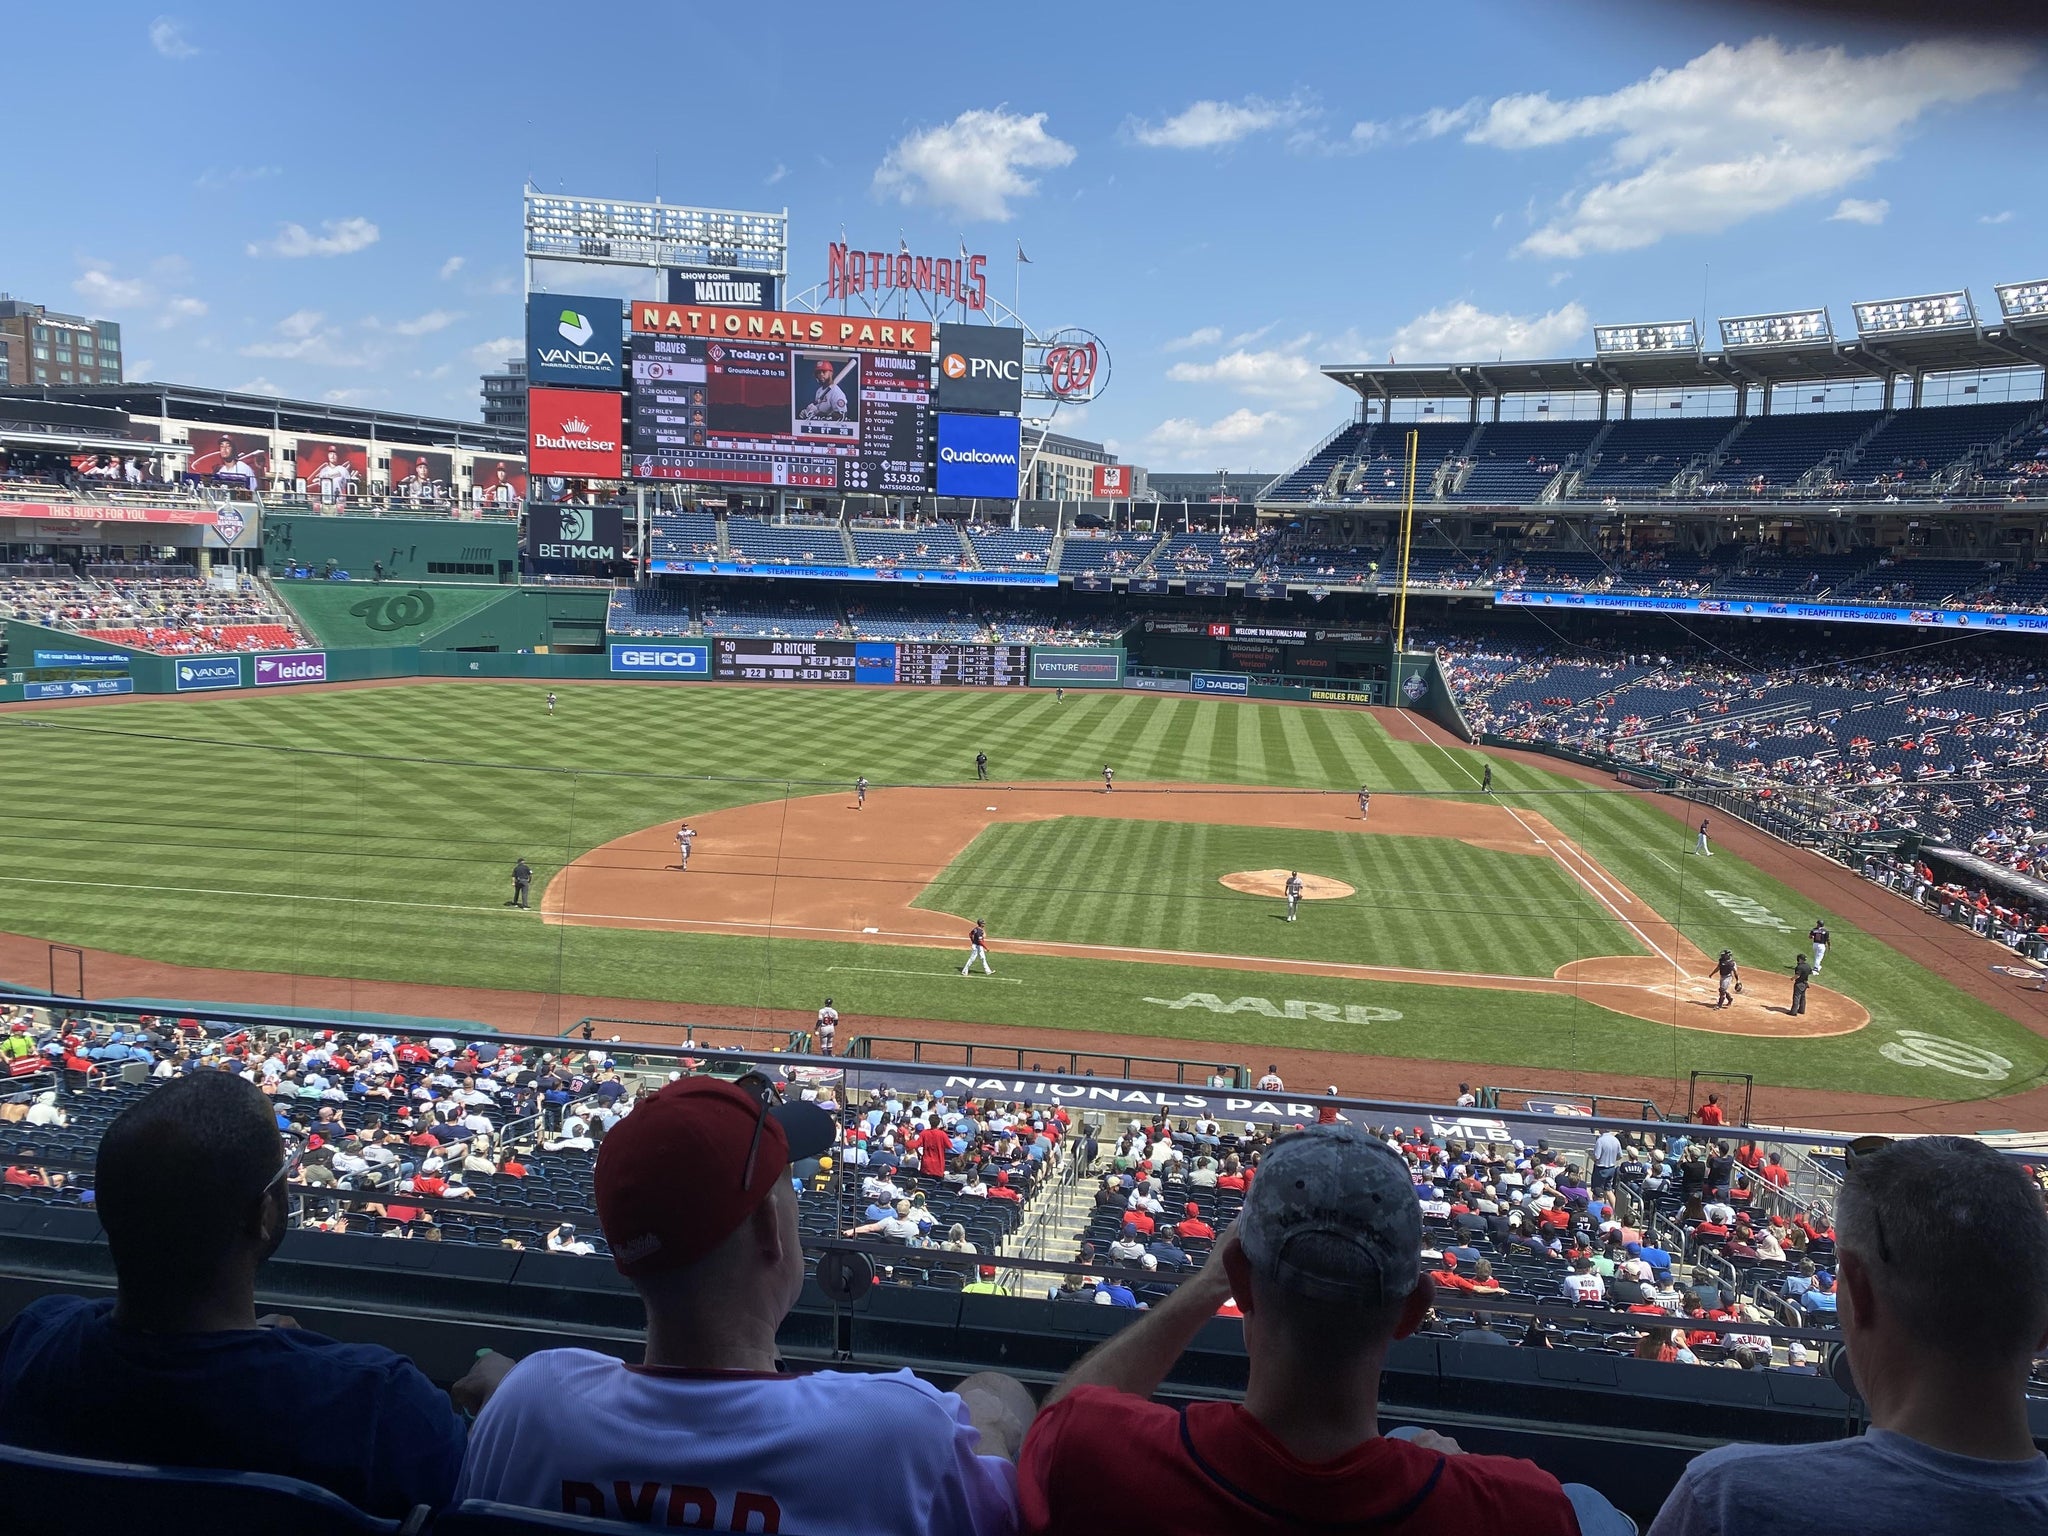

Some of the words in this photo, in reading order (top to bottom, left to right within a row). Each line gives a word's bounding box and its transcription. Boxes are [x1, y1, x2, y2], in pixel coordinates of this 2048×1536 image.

[681, 272, 702, 280] SHOW
[704, 273, 730, 281] SOME
[828, 242, 987, 310] NATIONALS
[695, 281, 762, 302] NATITUDE
[643, 308, 824, 339] NATIONALS
[840, 323, 917, 345] PARK
[655, 341, 687, 354] BRAVES
[538, 348, 615, 366] VANDA
[729, 349, 766, 361] Today:
[768, 352, 784, 361] 0-1
[874, 357, 916, 370] NATIONALS
[969, 358, 1019, 380] PNC
[728, 367, 761, 376] Groundout,
[535, 434, 615, 451] Budweiser
[940, 446, 1016, 464] Qualcomm
[10, 459, 37, 468] LOFT
[884, 473, 920, 483] $3,930
[880, 484, 925, 492] NATS5050.COM
[48, 505, 70, 517] THIS
[73, 506, 103, 518] BUD'S
[105, 507, 123, 519] FOR
[125, 508, 148, 520] YOU.
[539, 543, 614, 559] BETMGM
[767, 568, 849, 577] STEAMFITTERS-602.ORG
[968, 575, 1046, 584] STEAMFITTERS-602.ORG
[1595, 598, 1687, 610] STEAMFITTERS-602.ORG
[1768, 606, 1787, 614] MCA
[1798, 608, 1897, 620] STEAMFITTERS-602.ORG
[1985, 617, 2007, 626] MCA
[1213, 626, 1226, 635] 1:41
[1266, 629, 1293, 637] NATIONALS
[1293, 630, 1307, 638] PARK
[720, 641, 736, 652] #60
[771, 643, 783, 654] JR
[784, 643, 817, 655] RITCHIE
[1228, 643, 1261, 653] Nationals
[1262, 645, 1279, 653] Park
[621, 651, 696, 667] GEICO
[1232, 652, 1265, 660] powered
[1265, 653, 1274, 661] by
[1039, 663, 1079, 672] VENTURE
[1080, 664, 1113, 673] GLOBAL
[1239, 660, 1267, 668] Verizon
[1296, 658, 1327, 667] verizon
[193, 667, 236, 678] VANDA
[278, 661, 324, 678] leidos
[750, 669, 761, 677] 2.2
[807, 670, 818, 678] 0-0
[41, 685, 63, 693] MGM
[97, 681, 118, 689] MGM
[1144, 680, 1157, 688] RTX
[1206, 681, 1246, 691] DABOS
[1312, 691, 1346, 701] HERCULES
[1347, 694, 1369, 702] FENCE
[1142, 991, 1404, 1025] AARP
[1266, 1083, 1279, 1092] 22
[1431, 1123, 1512, 1142] MLB
[1579, 1280, 1596, 1288] WOOD
[1578, 1289, 1600, 1300] 29
